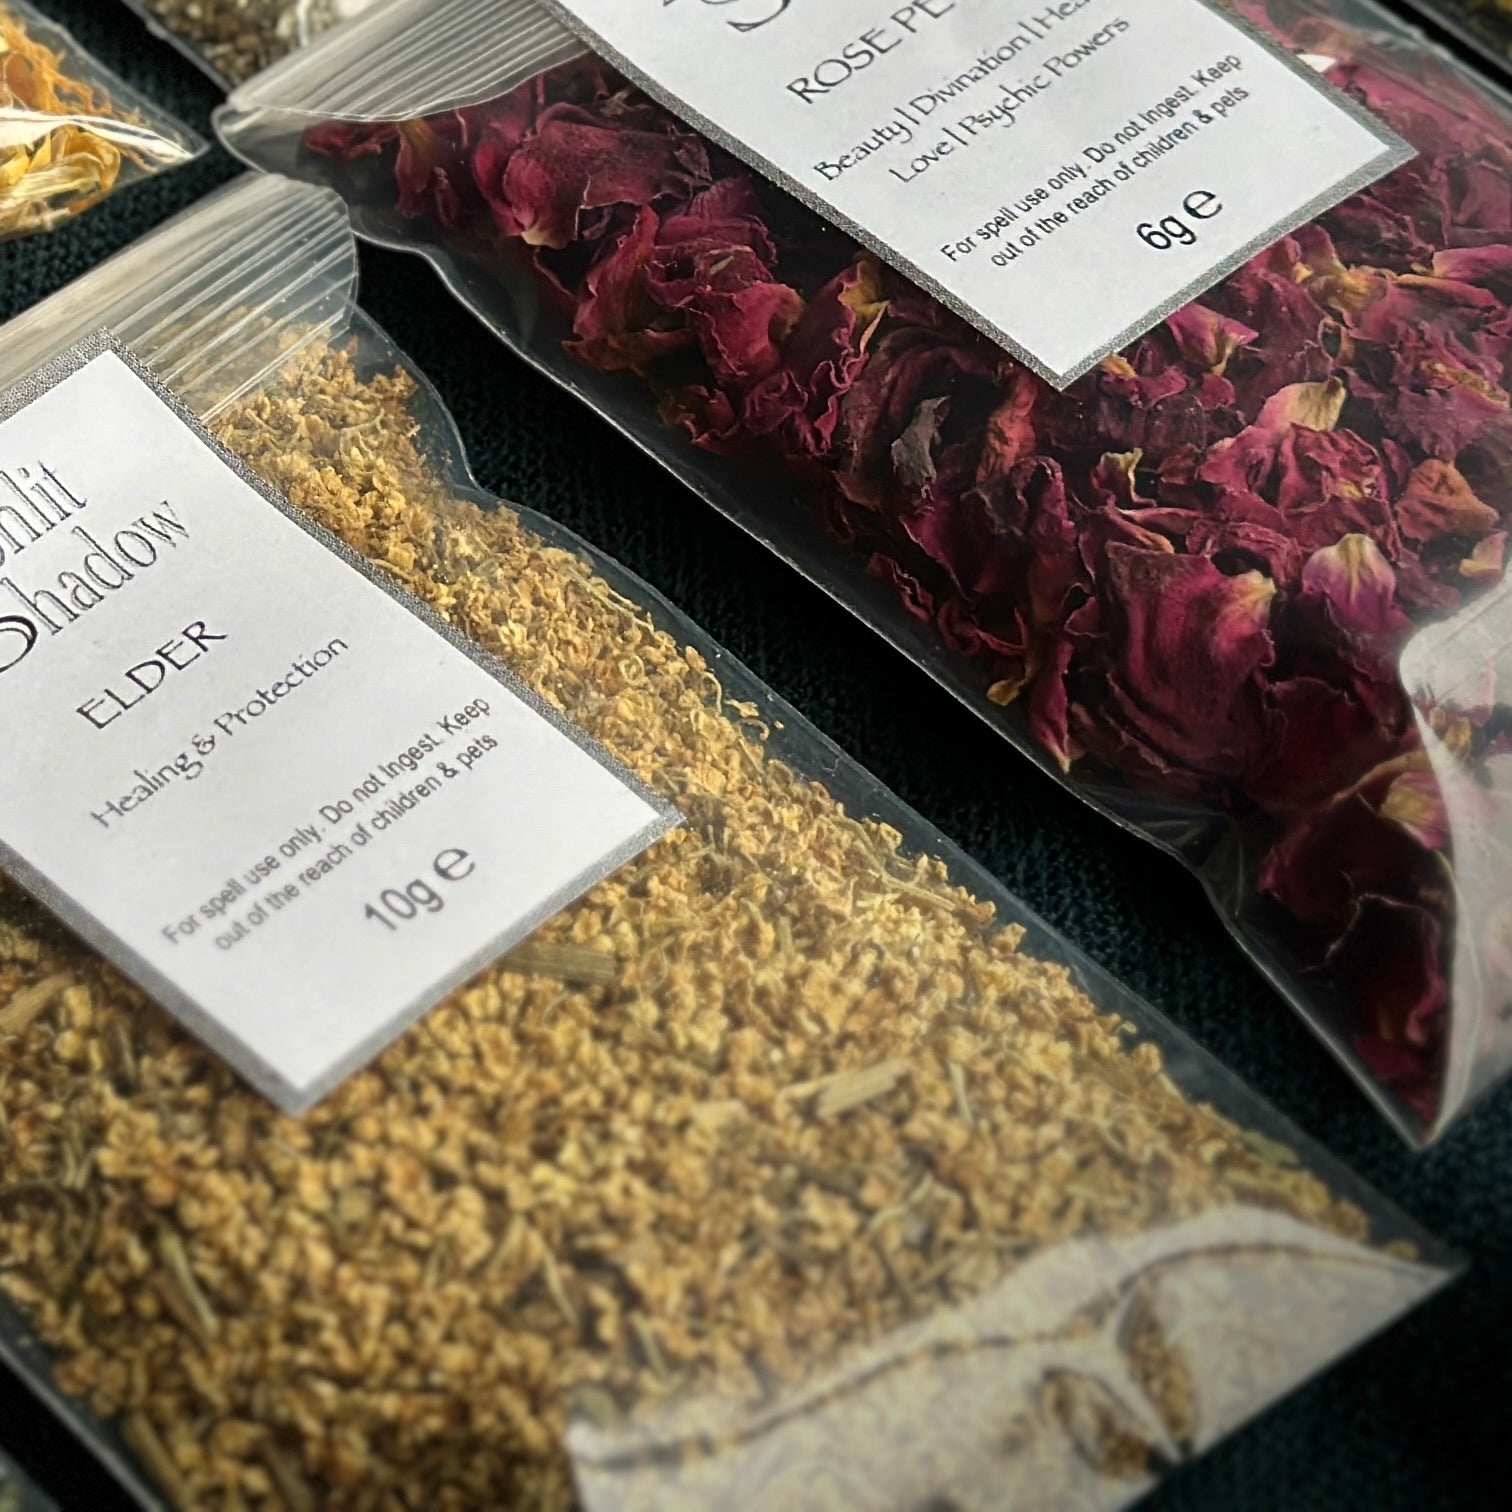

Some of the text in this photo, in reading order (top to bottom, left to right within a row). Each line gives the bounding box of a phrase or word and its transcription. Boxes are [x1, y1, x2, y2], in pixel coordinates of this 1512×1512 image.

[785, 27, 903, 105] ROSE
[812, 120, 914, 181] Beauty
[908, 35, 1032, 117] Divination
[887, 141, 955, 184] Love
[956, 75, 1052, 136] Psychic
[1041, 17, 1130, 78] Powers
[940, 236, 978, 263] For
[975, 206, 1020, 241] spell
[1013, 187, 1051, 213] use
[1047, 162, 1092, 191] only.
[1081, 142, 1117, 164] Do
[1113, 119, 1148, 146] not
[1190, 55, 1243, 88] Keep
[990, 86, 1250, 267] out of the reach of children & pets
[1136, 215, 1198, 250] 6g
[75, 620, 228, 730] ELDER
[89, 638, 349, 829] Healing & Protection
[160, 698, 491, 945] For spell use only. Do not Ingest. Keep
[213, 734, 499, 952] out of the reach of children & pets
[363, 878, 445, 932] 10g
